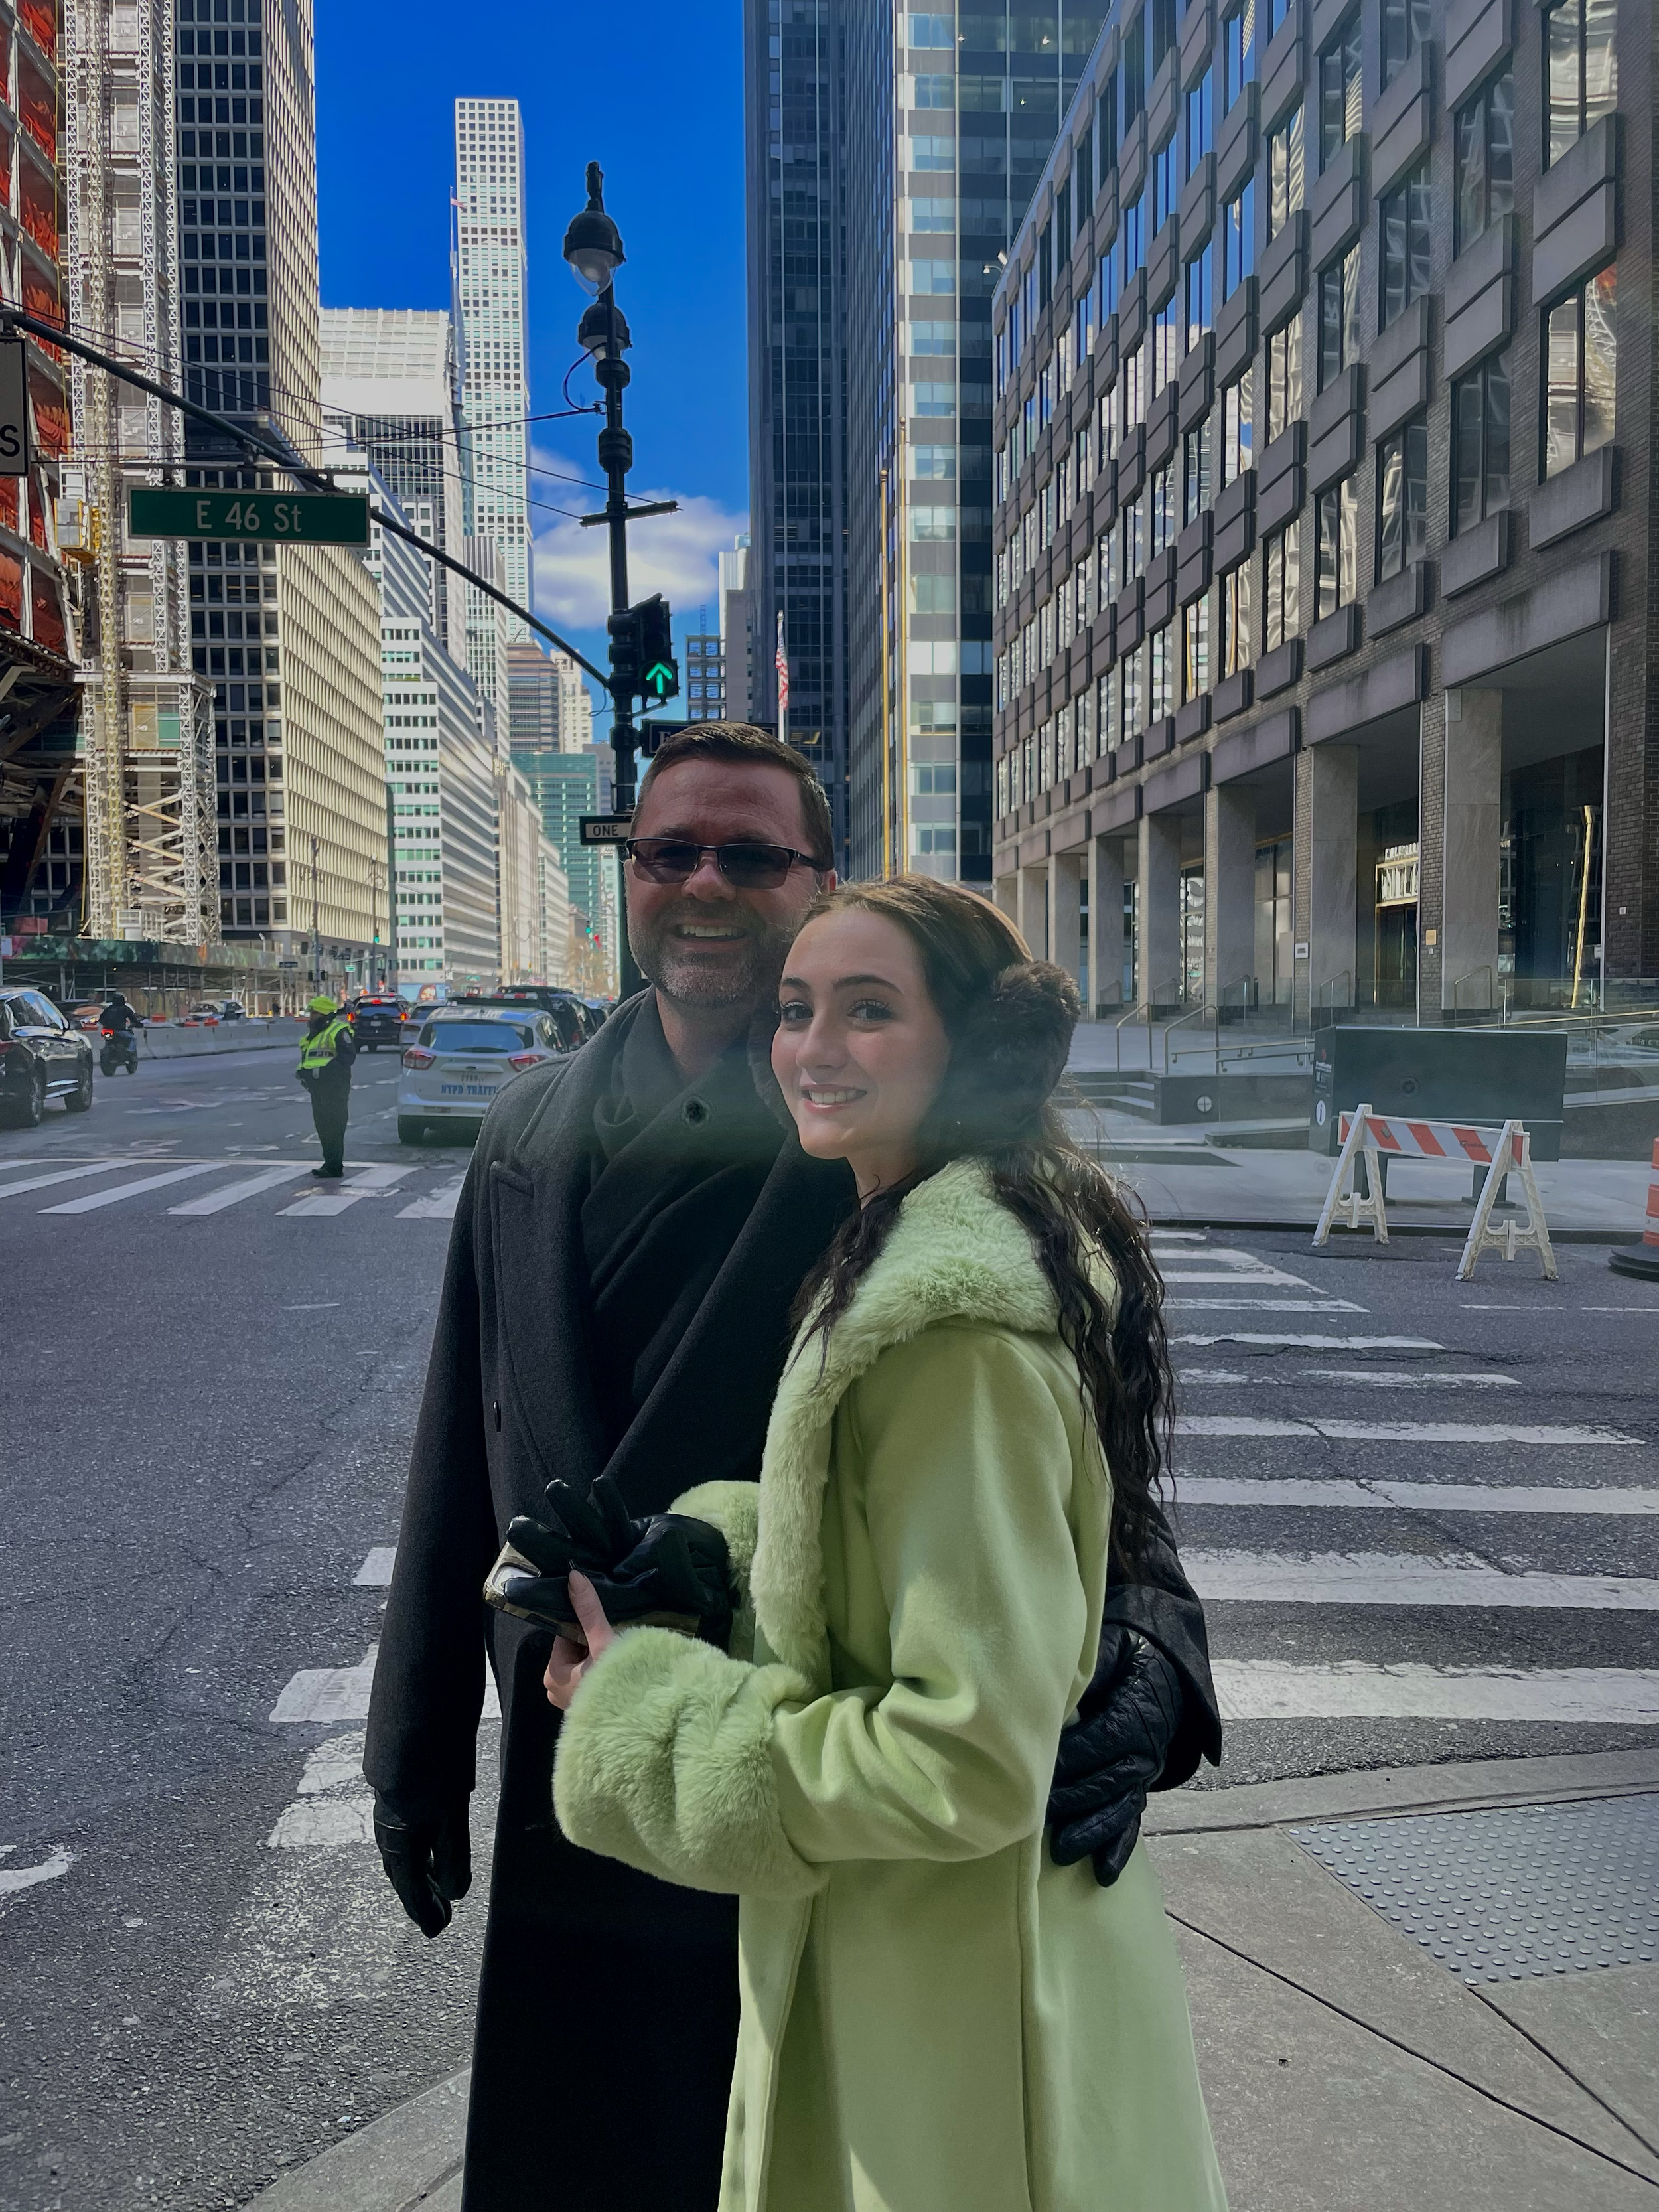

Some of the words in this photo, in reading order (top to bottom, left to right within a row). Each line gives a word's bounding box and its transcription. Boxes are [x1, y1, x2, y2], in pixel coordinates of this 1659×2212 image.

[196, 500, 212, 529] E
[224, 501, 260, 532] 46
[273, 502, 302, 532] St
[593, 825, 619, 837] ONE
[441, 1084, 463, 1095] NYPD
[467, 1085, 497, 1096] TRAFFI
